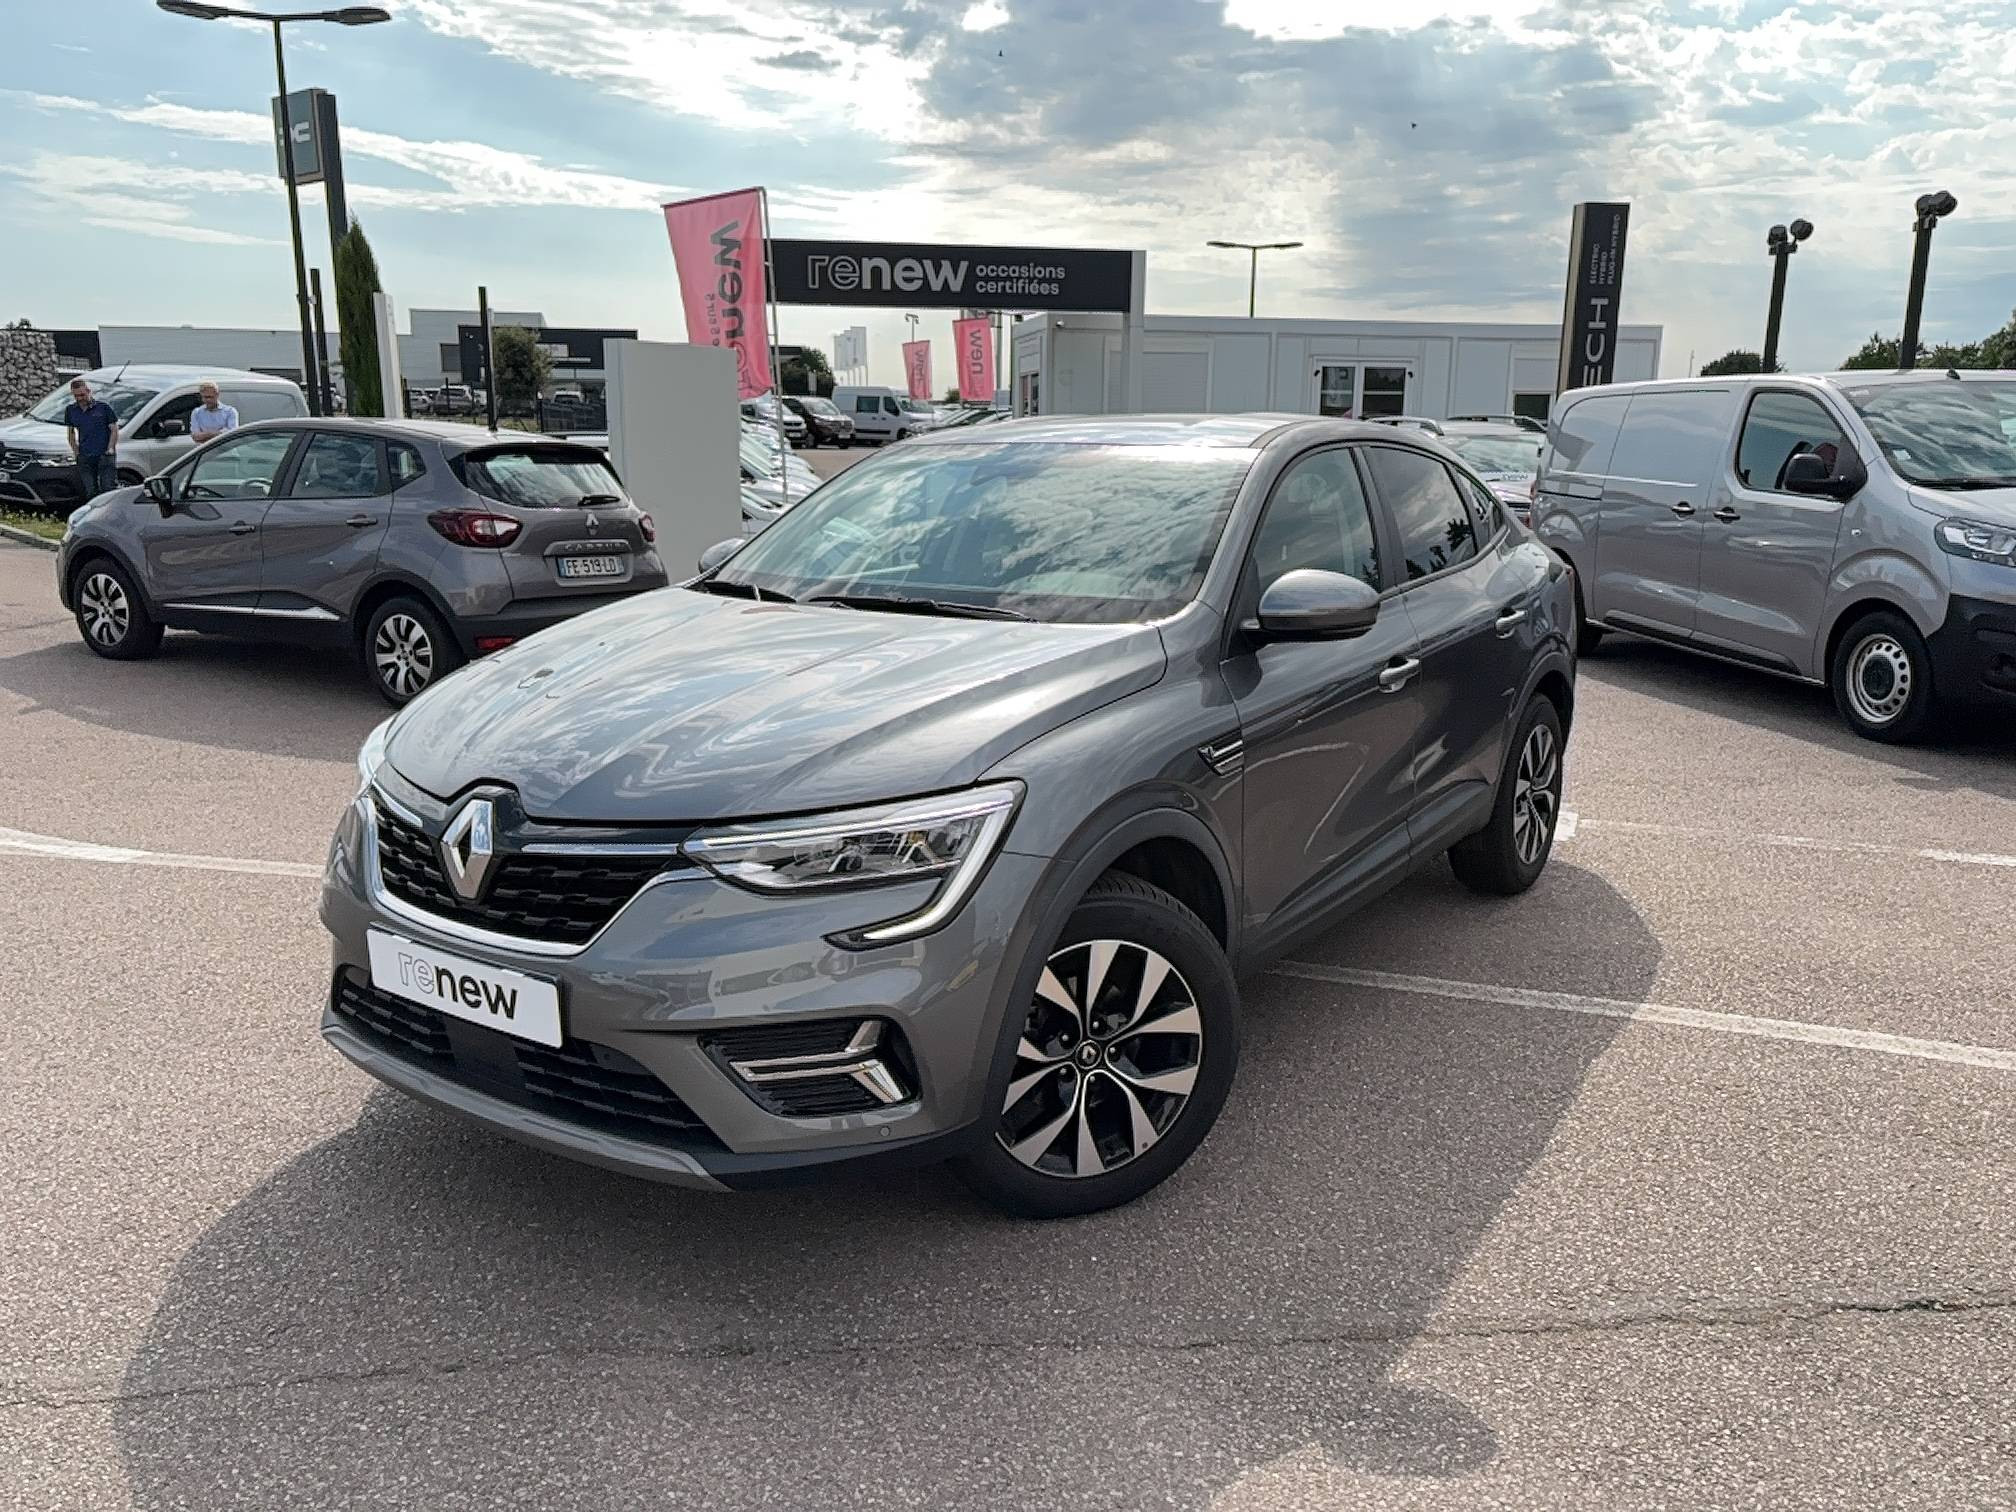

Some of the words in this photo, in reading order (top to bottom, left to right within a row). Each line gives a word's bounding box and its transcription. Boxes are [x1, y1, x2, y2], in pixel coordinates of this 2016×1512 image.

[807, 255, 969, 292] renew
[975, 263, 1066, 280] occasions
[975, 279, 1061, 296] certifiées
[398, 952, 518, 1020] renew
